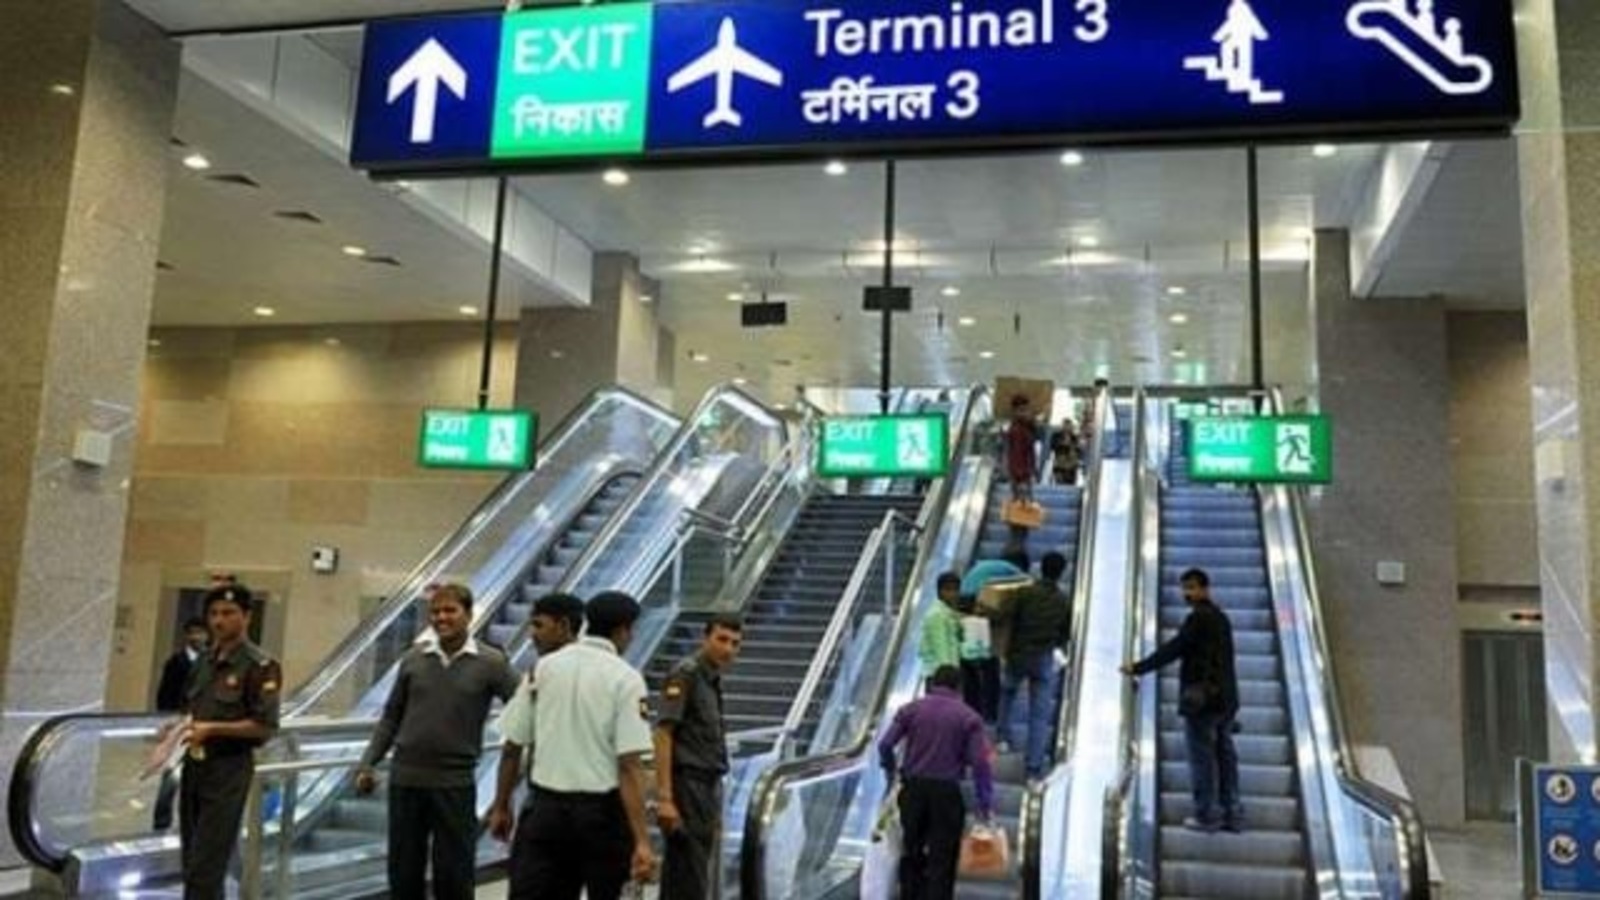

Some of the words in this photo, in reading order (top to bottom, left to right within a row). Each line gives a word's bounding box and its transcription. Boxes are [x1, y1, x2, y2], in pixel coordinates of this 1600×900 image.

[512, 20, 636, 75] EXIT
[804, 0, 1053, 56] Terminal
[1074, 0, 1109, 42] 3
[945, 70, 980, 118] 3
[511, 95, 628, 137] निकास
[426, 414, 469, 435] EXIT
[825, 420, 877, 441] EXIT
[1193, 420, 1252, 444] EXIT
